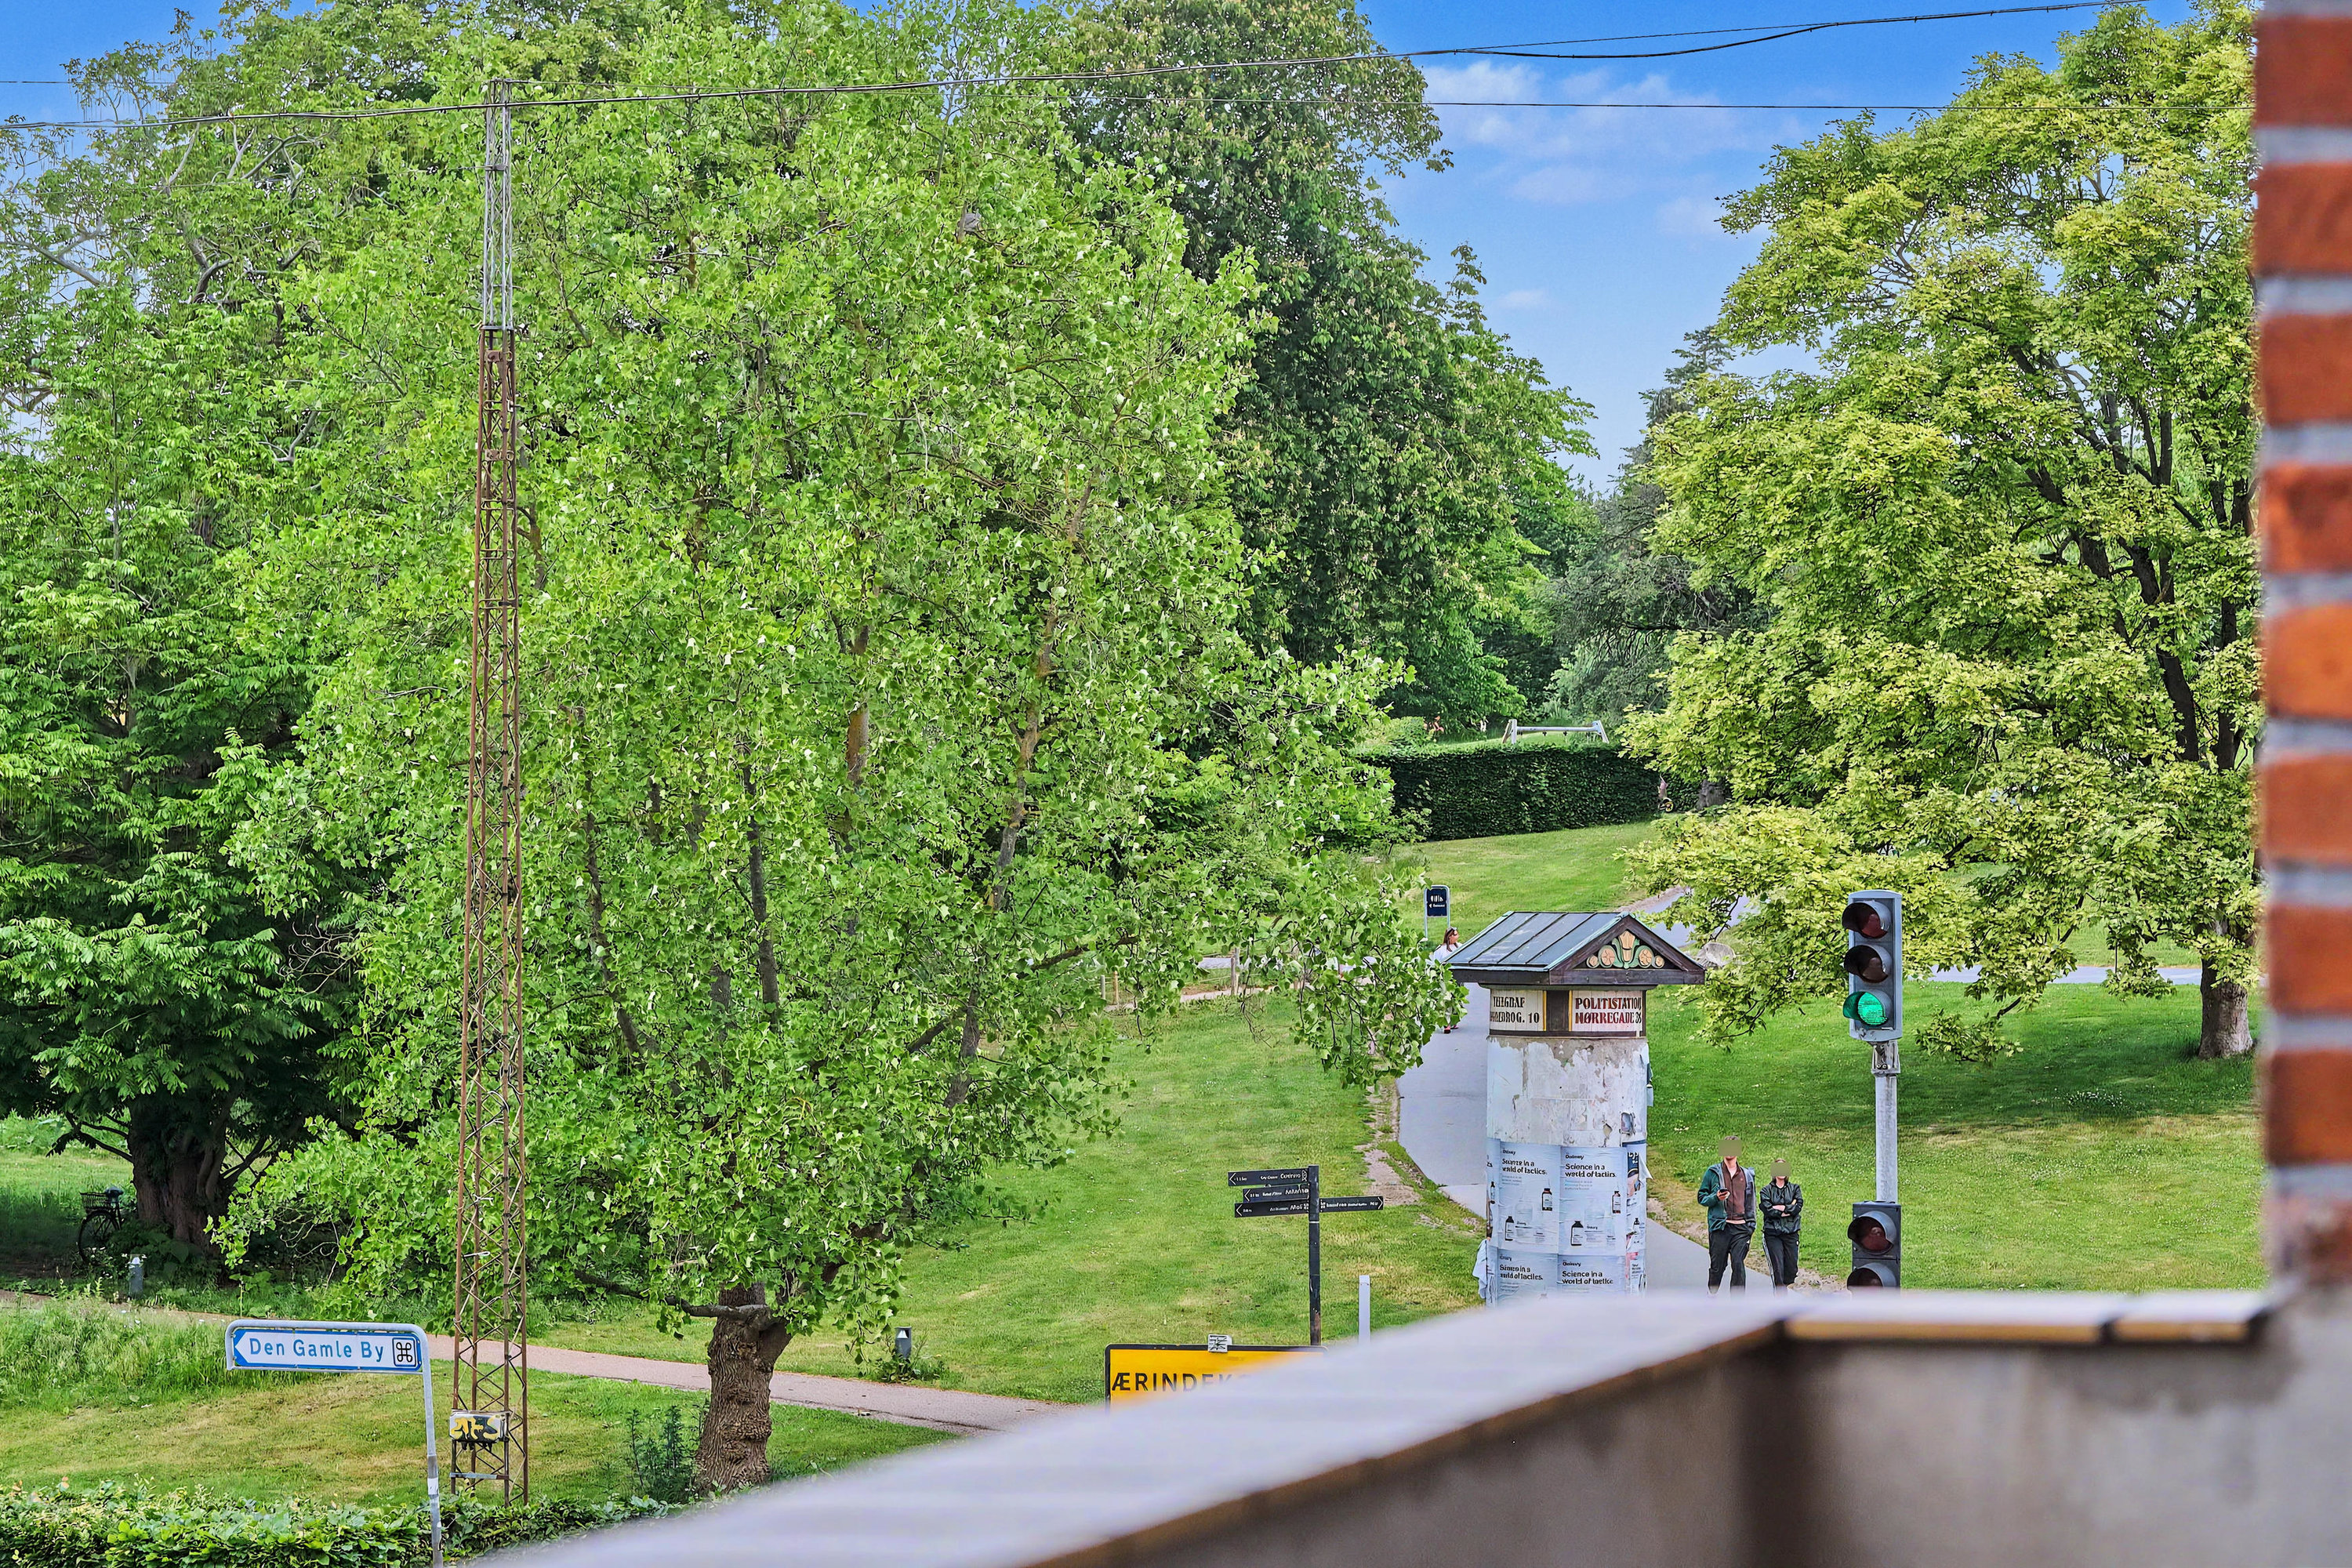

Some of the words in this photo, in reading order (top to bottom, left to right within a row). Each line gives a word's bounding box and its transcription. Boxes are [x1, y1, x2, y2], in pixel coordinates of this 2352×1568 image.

[1527, 1012, 1540, 1023] 10
[1575, 1011, 1634, 1024] NØRREGADE
[249, 1338, 285, 1356] Den
[292, 1339, 352, 1359] Gamle
[361, 1341, 384, 1363] By
